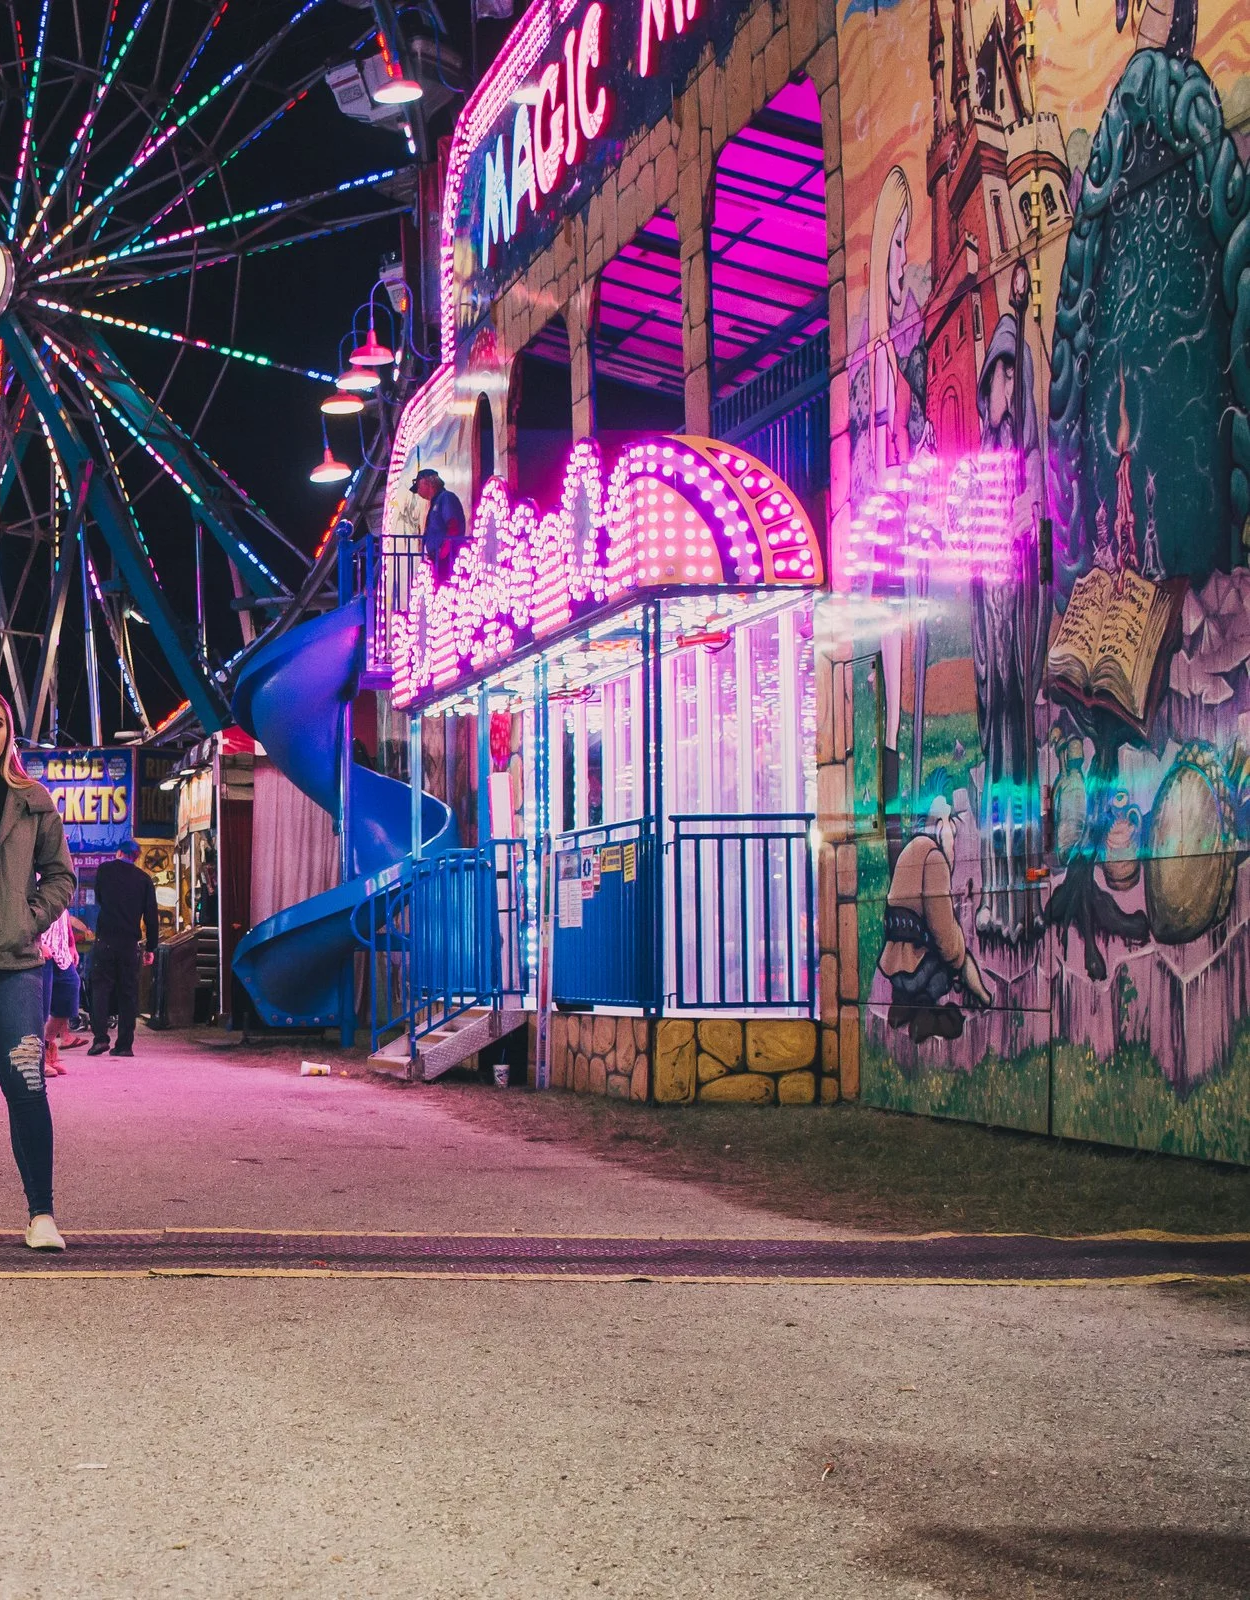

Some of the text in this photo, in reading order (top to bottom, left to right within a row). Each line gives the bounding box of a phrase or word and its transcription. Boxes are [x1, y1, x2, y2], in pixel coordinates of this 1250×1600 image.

[482, 2, 607, 270] MAGIC
[47, 758, 104, 781] RIDE
[52, 786, 127, 823] CKETS
[84, 856, 99, 865] the
